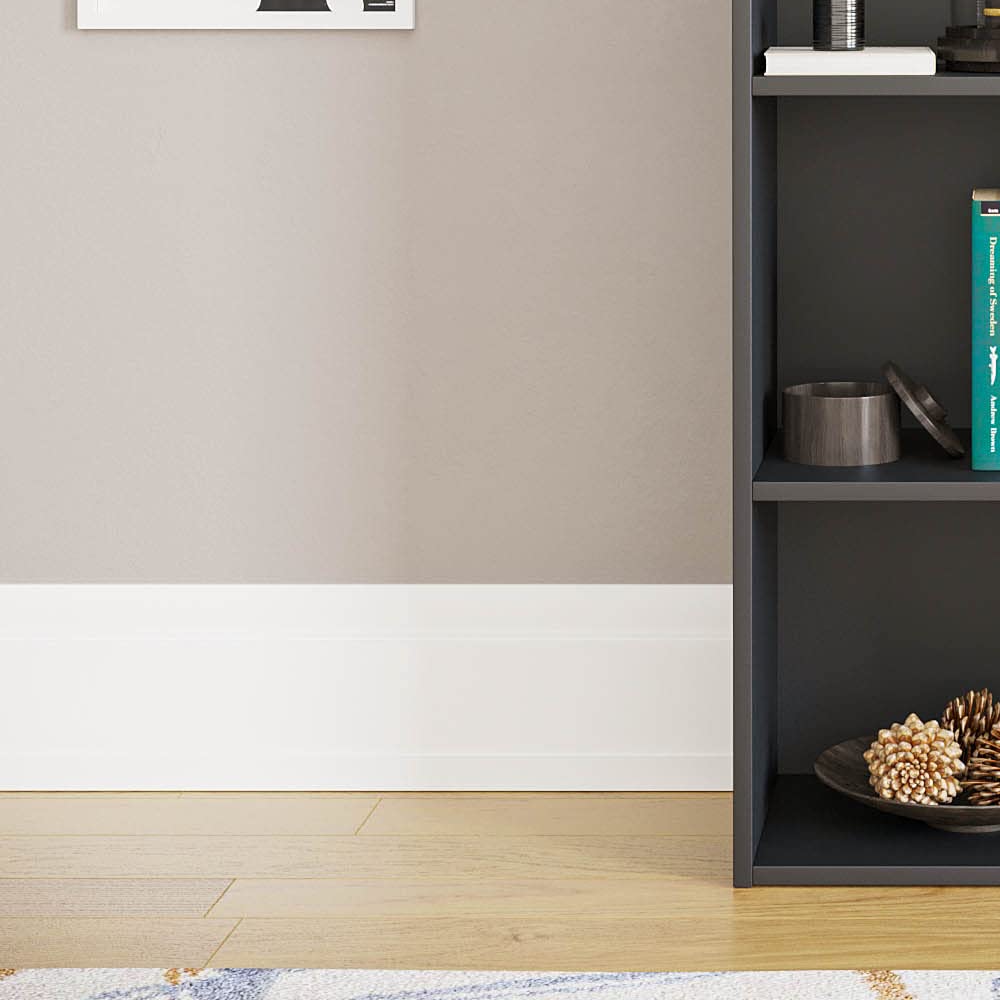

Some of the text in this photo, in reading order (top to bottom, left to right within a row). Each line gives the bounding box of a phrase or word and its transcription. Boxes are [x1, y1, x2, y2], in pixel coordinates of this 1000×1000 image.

[988, 236, 998, 337] Dreaming of Sweden
[990, 395, 998, 453] Andrew Brown
